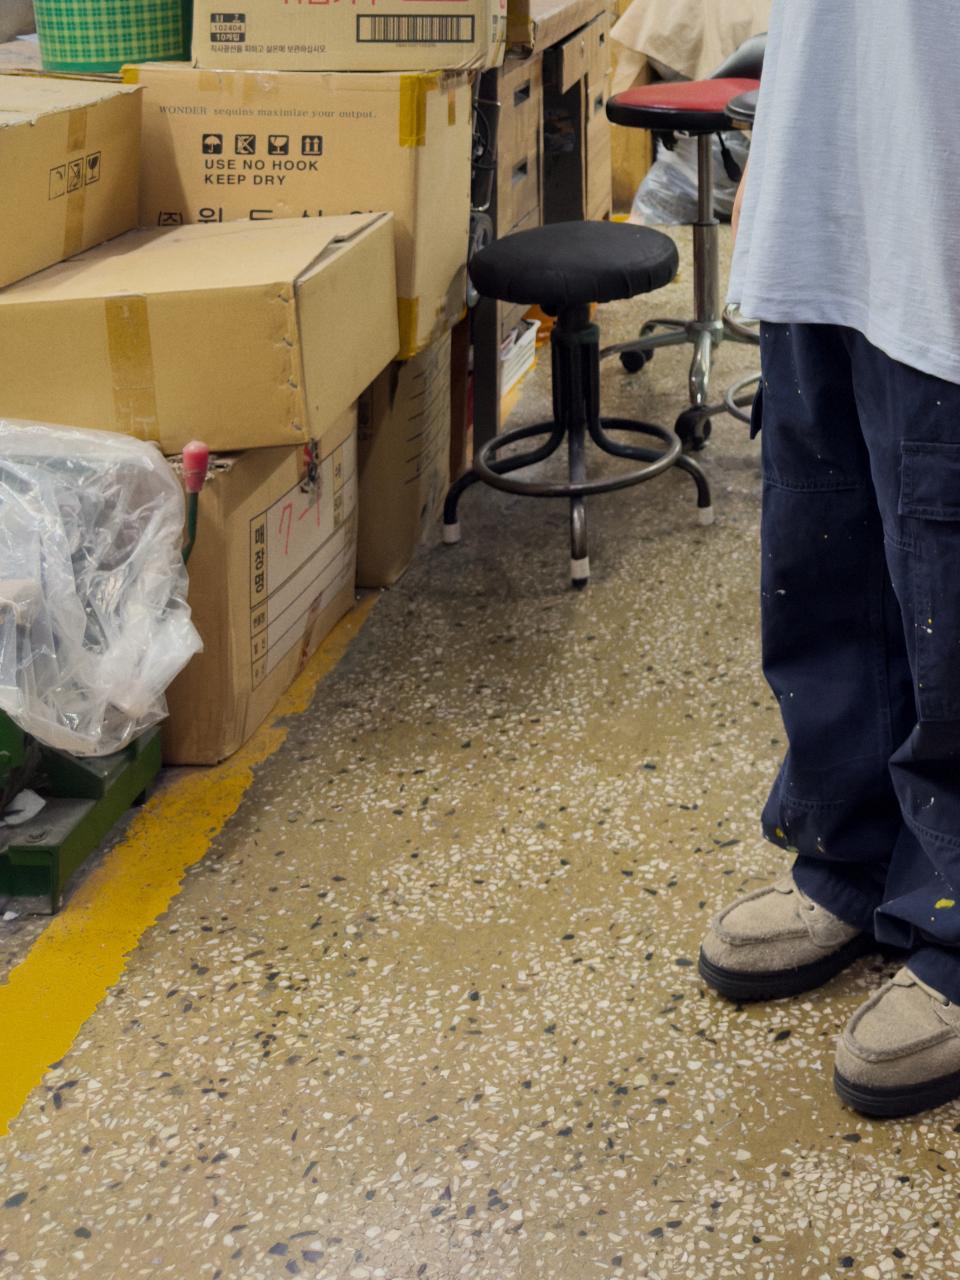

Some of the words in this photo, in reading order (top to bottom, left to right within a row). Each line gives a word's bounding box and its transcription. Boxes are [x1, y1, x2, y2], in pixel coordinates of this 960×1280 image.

[159, 105, 207, 116] WONDER
[213, 106, 253, 118] sequins
[310, 108, 336, 120] your
[204, 159, 236, 170] USE
[243, 160, 265, 170] NO
[272, 160, 319, 172] HOOK
[204, 173, 247, 185] KEEP
[253, 174, 287, 186] DRY
